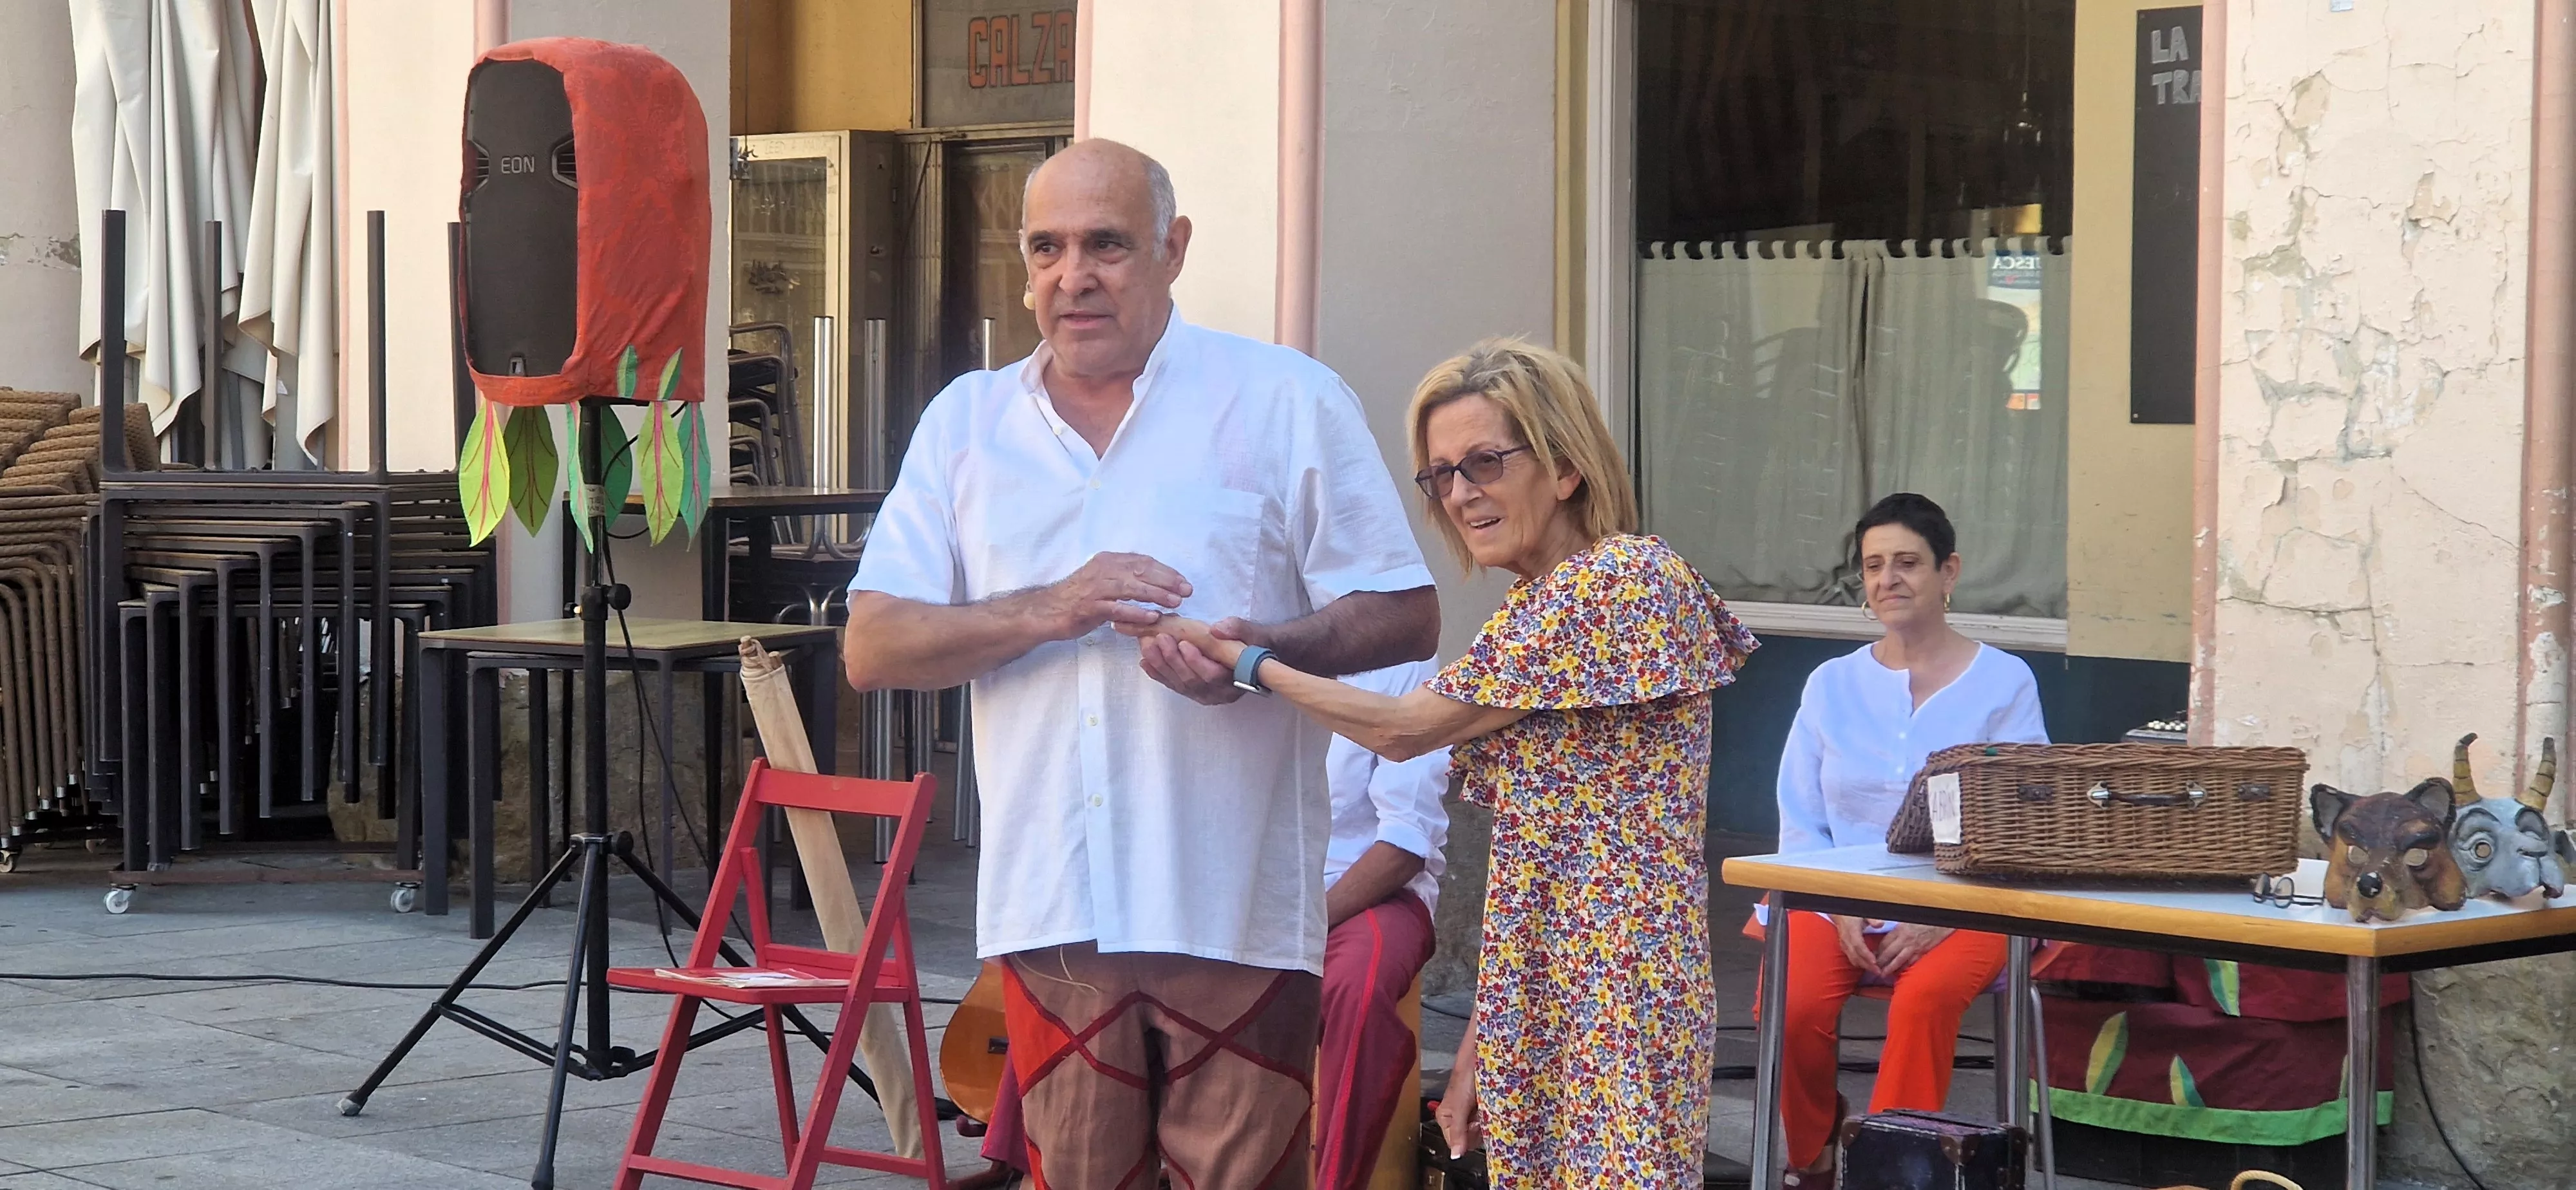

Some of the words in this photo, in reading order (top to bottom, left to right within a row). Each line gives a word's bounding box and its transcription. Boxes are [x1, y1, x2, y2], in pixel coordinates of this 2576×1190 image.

[968, 8, 1075, 89] CALZA
[2151, 26, 2189, 64] LA
[501, 156, 535, 174] EON
